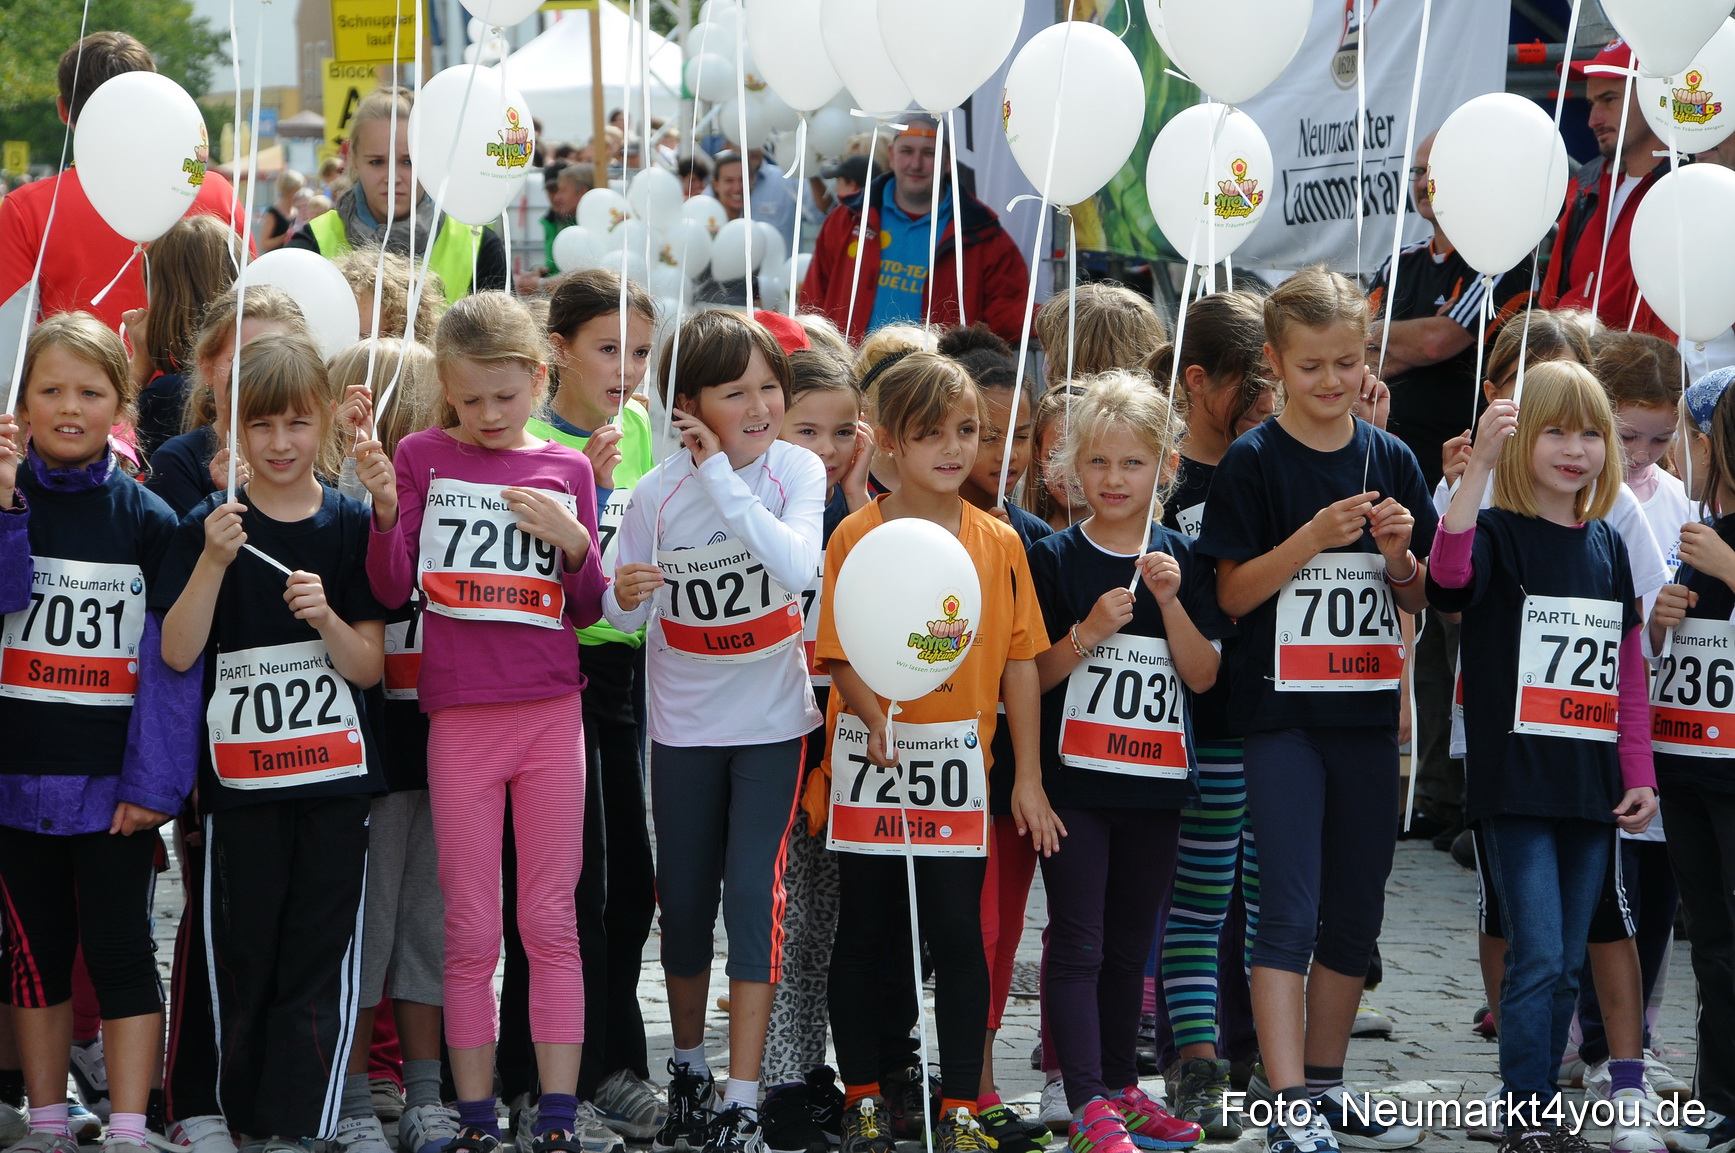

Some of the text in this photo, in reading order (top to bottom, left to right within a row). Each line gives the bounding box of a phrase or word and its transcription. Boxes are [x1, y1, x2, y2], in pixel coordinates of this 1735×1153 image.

[366, 32, 393, 46] lauf
[329, 63, 376, 79] Block
[1337, 55, 1356, 75] 1628
[427, 494, 477, 508] PARTL
[604, 503, 625, 516] RTL
[438, 518, 555, 576] 7209
[657, 560, 686, 574] RTL
[1290, 567, 1332, 581] ARTL
[31, 571, 126, 592] RTL Neumarkt
[455, 580, 540, 608] Theresa
[663, 564, 771, 621] 7027
[21, 592, 126, 650] 7031
[1295, 587, 1395, 638] 7024
[1527, 609, 1623, 631] PARTL Neuma
[703, 632, 756, 651] Luca
[28, 658, 110, 687] Samina
[219, 655, 324, 681] PARTL Neumarkt
[1328, 652, 1380, 674] Lucia
[1540, 634, 1619, 692] 725
[228, 674, 342, 735] 7022
[1086, 664, 1180, 725] 7032
[838, 727, 959, 750] PART eumarkt
[1653, 713, 1703, 740] Emma
[248, 745, 330, 772] Tamina
[1106, 733, 1162, 760] Mona
[848, 753, 969, 808] 7250
[874, 814, 936, 838] Alicia
[986, 1111, 1004, 1120] FILA
